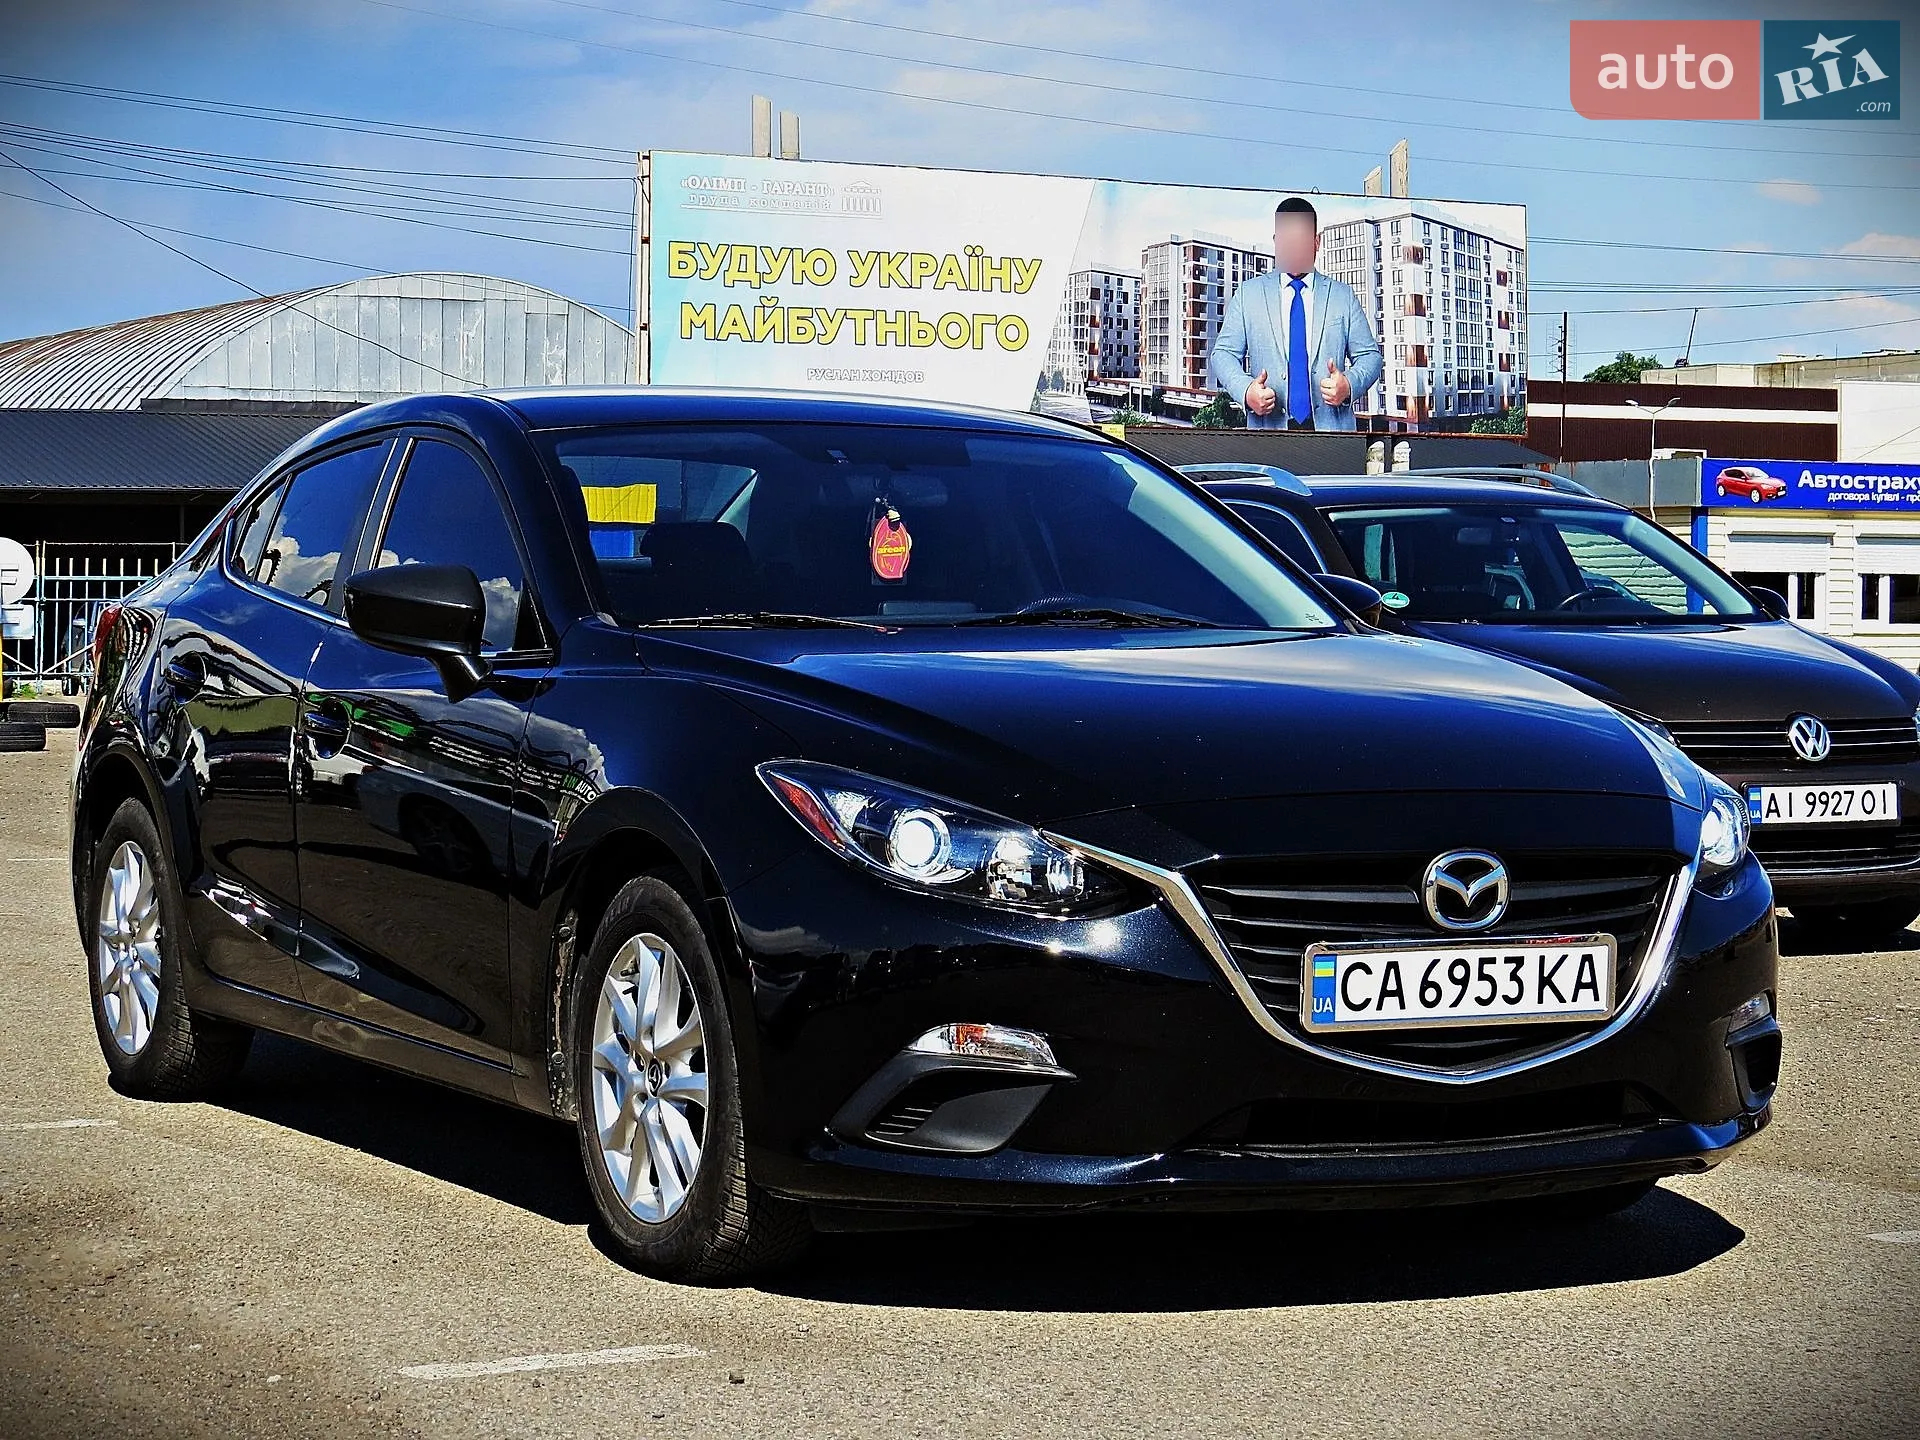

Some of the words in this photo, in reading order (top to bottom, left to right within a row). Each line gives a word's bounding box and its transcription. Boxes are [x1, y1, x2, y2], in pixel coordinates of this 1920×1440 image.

[688, 193, 740, 207] група
[668, 241, 837, 289] БУДУЮ
[848, 244, 1042, 294] УКРАЇНУ
[680, 296, 1030, 352] МАЙБУТНЬОГО
[807, 368, 860, 381] РУСЛАН
[861, 370, 924, 384] ХОМІДОВ
[1828, 492, 1870, 503] договора
[1805, 791, 1855, 817] 9927
[1341, 960, 1406, 1012] CA
[1419, 955, 1525, 1009] 6953
[1537, 953, 1600, 1005] KA
[1313, 997, 1334, 1013] UA
